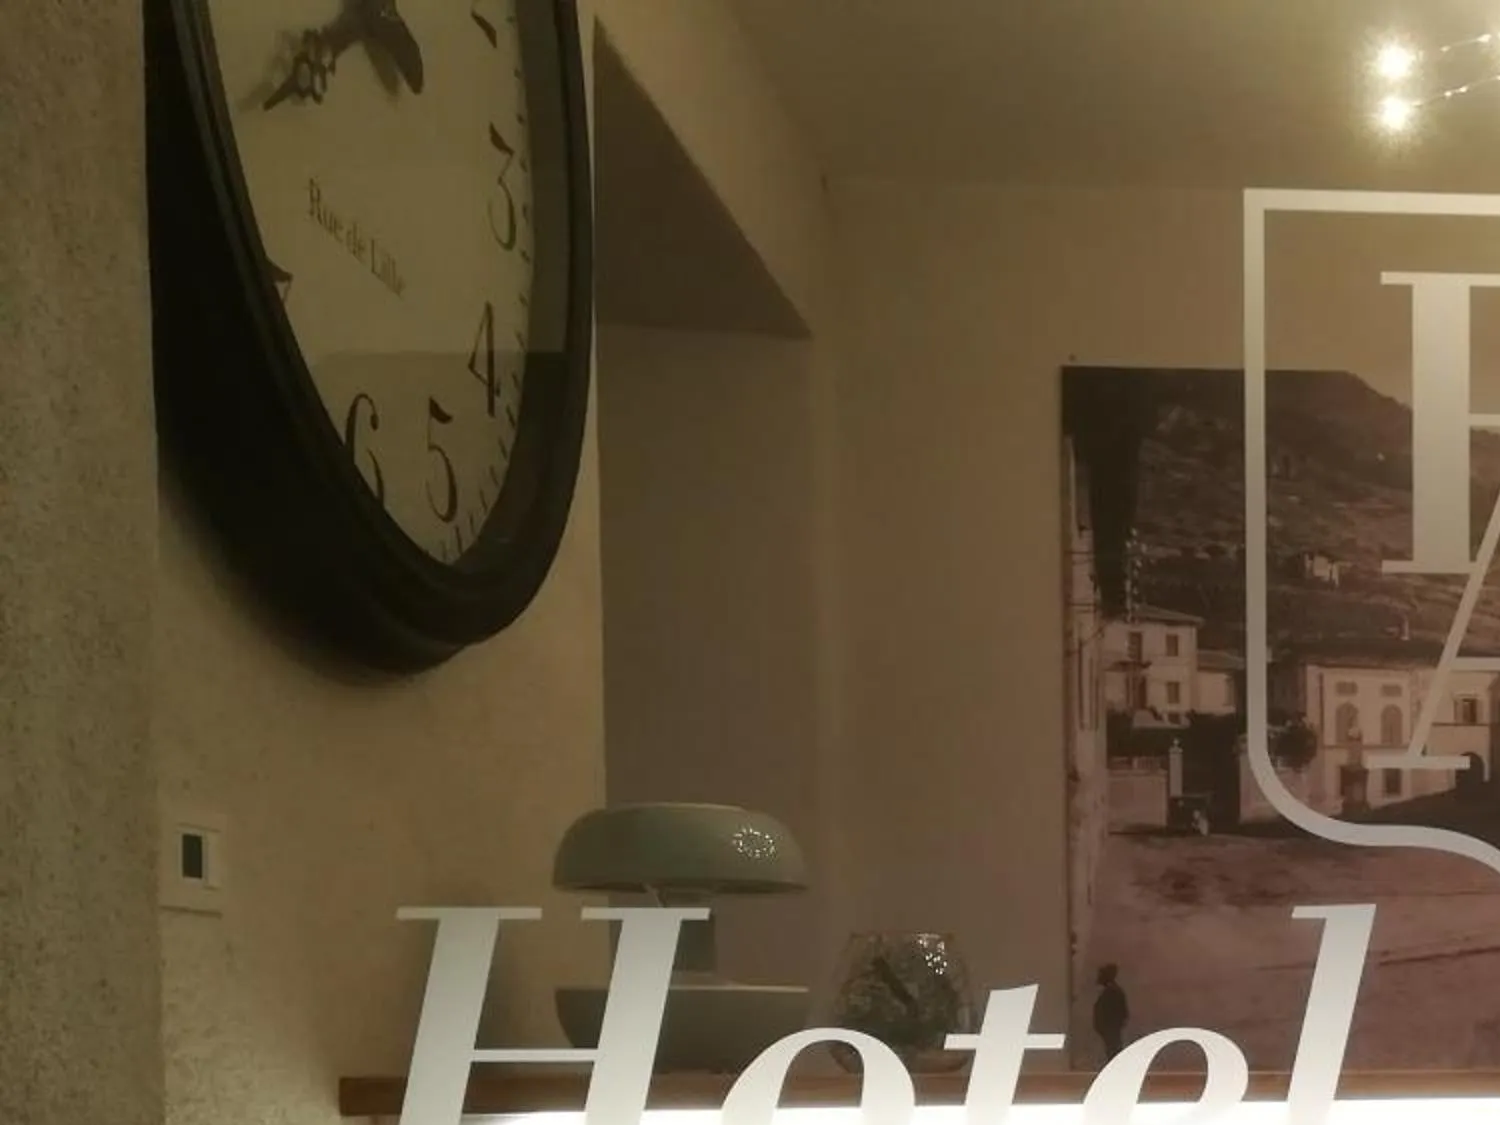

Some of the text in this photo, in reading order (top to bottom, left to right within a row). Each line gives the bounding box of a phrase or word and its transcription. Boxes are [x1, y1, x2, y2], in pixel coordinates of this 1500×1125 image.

[306, 175, 344, 244] Rue
[487, 121, 517, 251] 3
[468, 301, 501, 418] 4
[426, 396, 458, 524] 5
